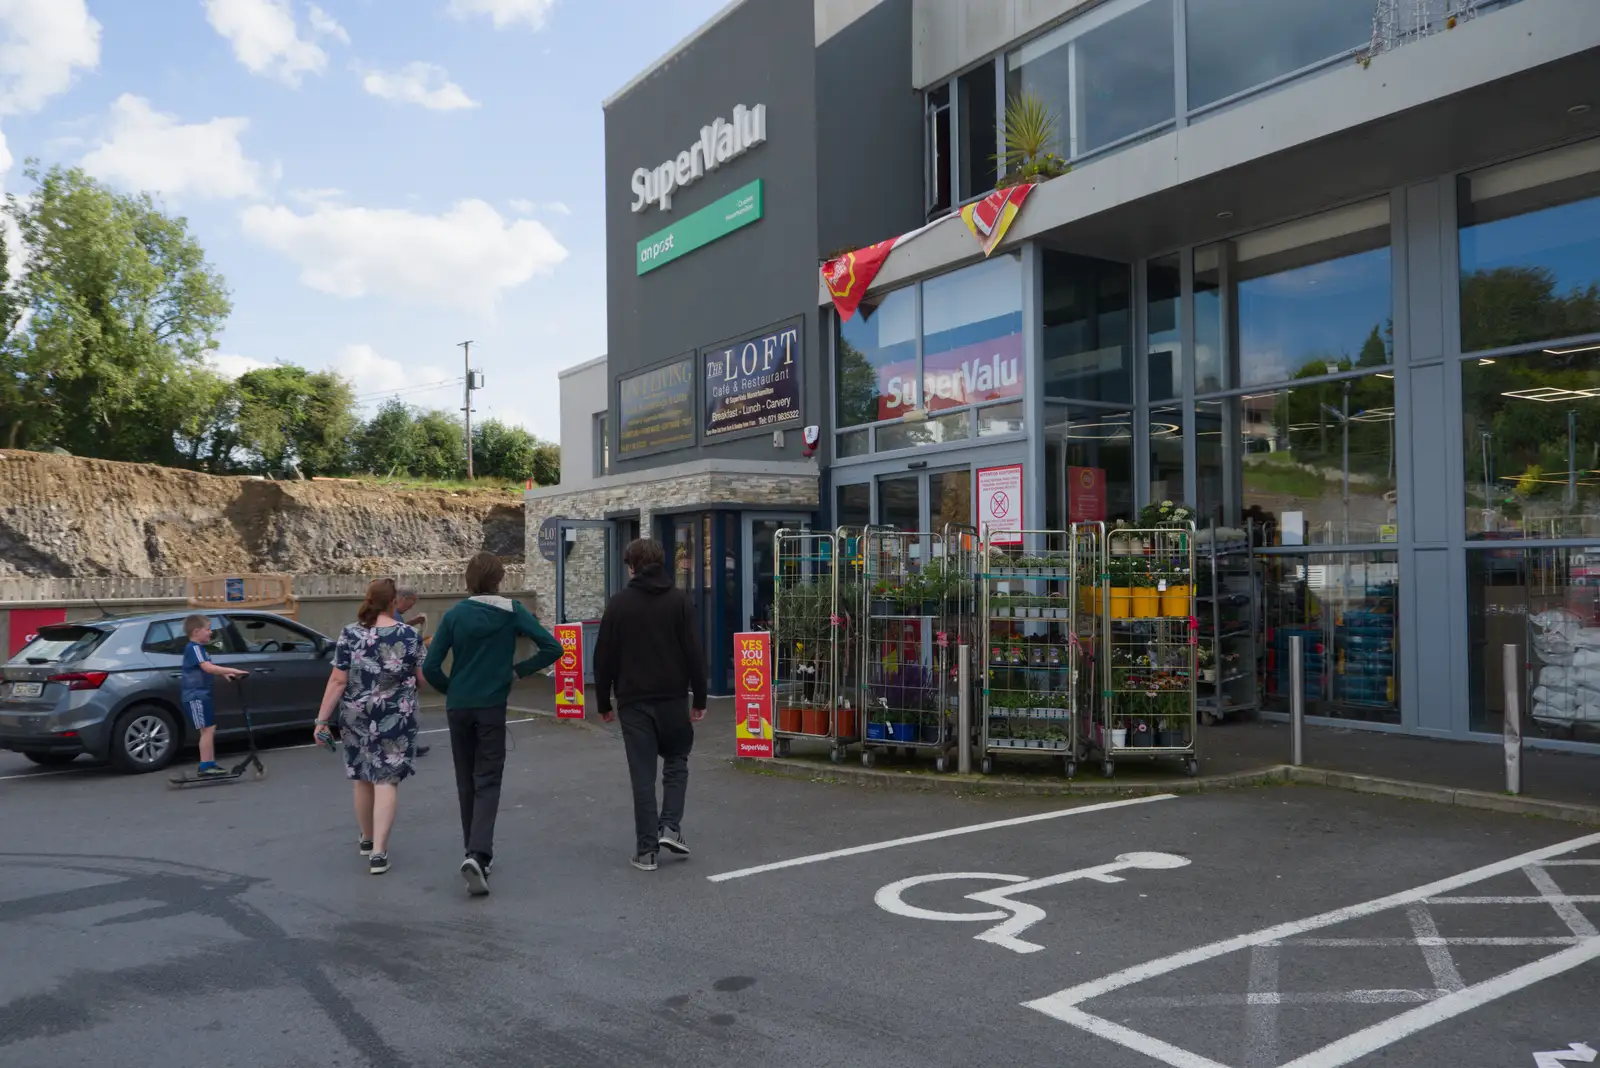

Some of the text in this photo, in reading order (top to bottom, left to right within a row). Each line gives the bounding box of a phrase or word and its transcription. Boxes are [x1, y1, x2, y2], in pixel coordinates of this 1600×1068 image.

[631, 103, 767, 213] SuperValu
[724, 329, 797, 381] LOFT
[712, 368, 789, 398] Café & Restaurant
[886, 353, 1018, 413] SuperValu
[711, 408, 738, 422] Breakfast
[743, 402, 761, 415] Lunch
[766, 396, 791, 410] Carvery
[559, 630, 576, 638] YES
[559, 637, 576, 645] YOU
[741, 639, 763, 650] YES
[741, 650, 763, 659] YOU
[740, 743, 769, 752] SuperValu
